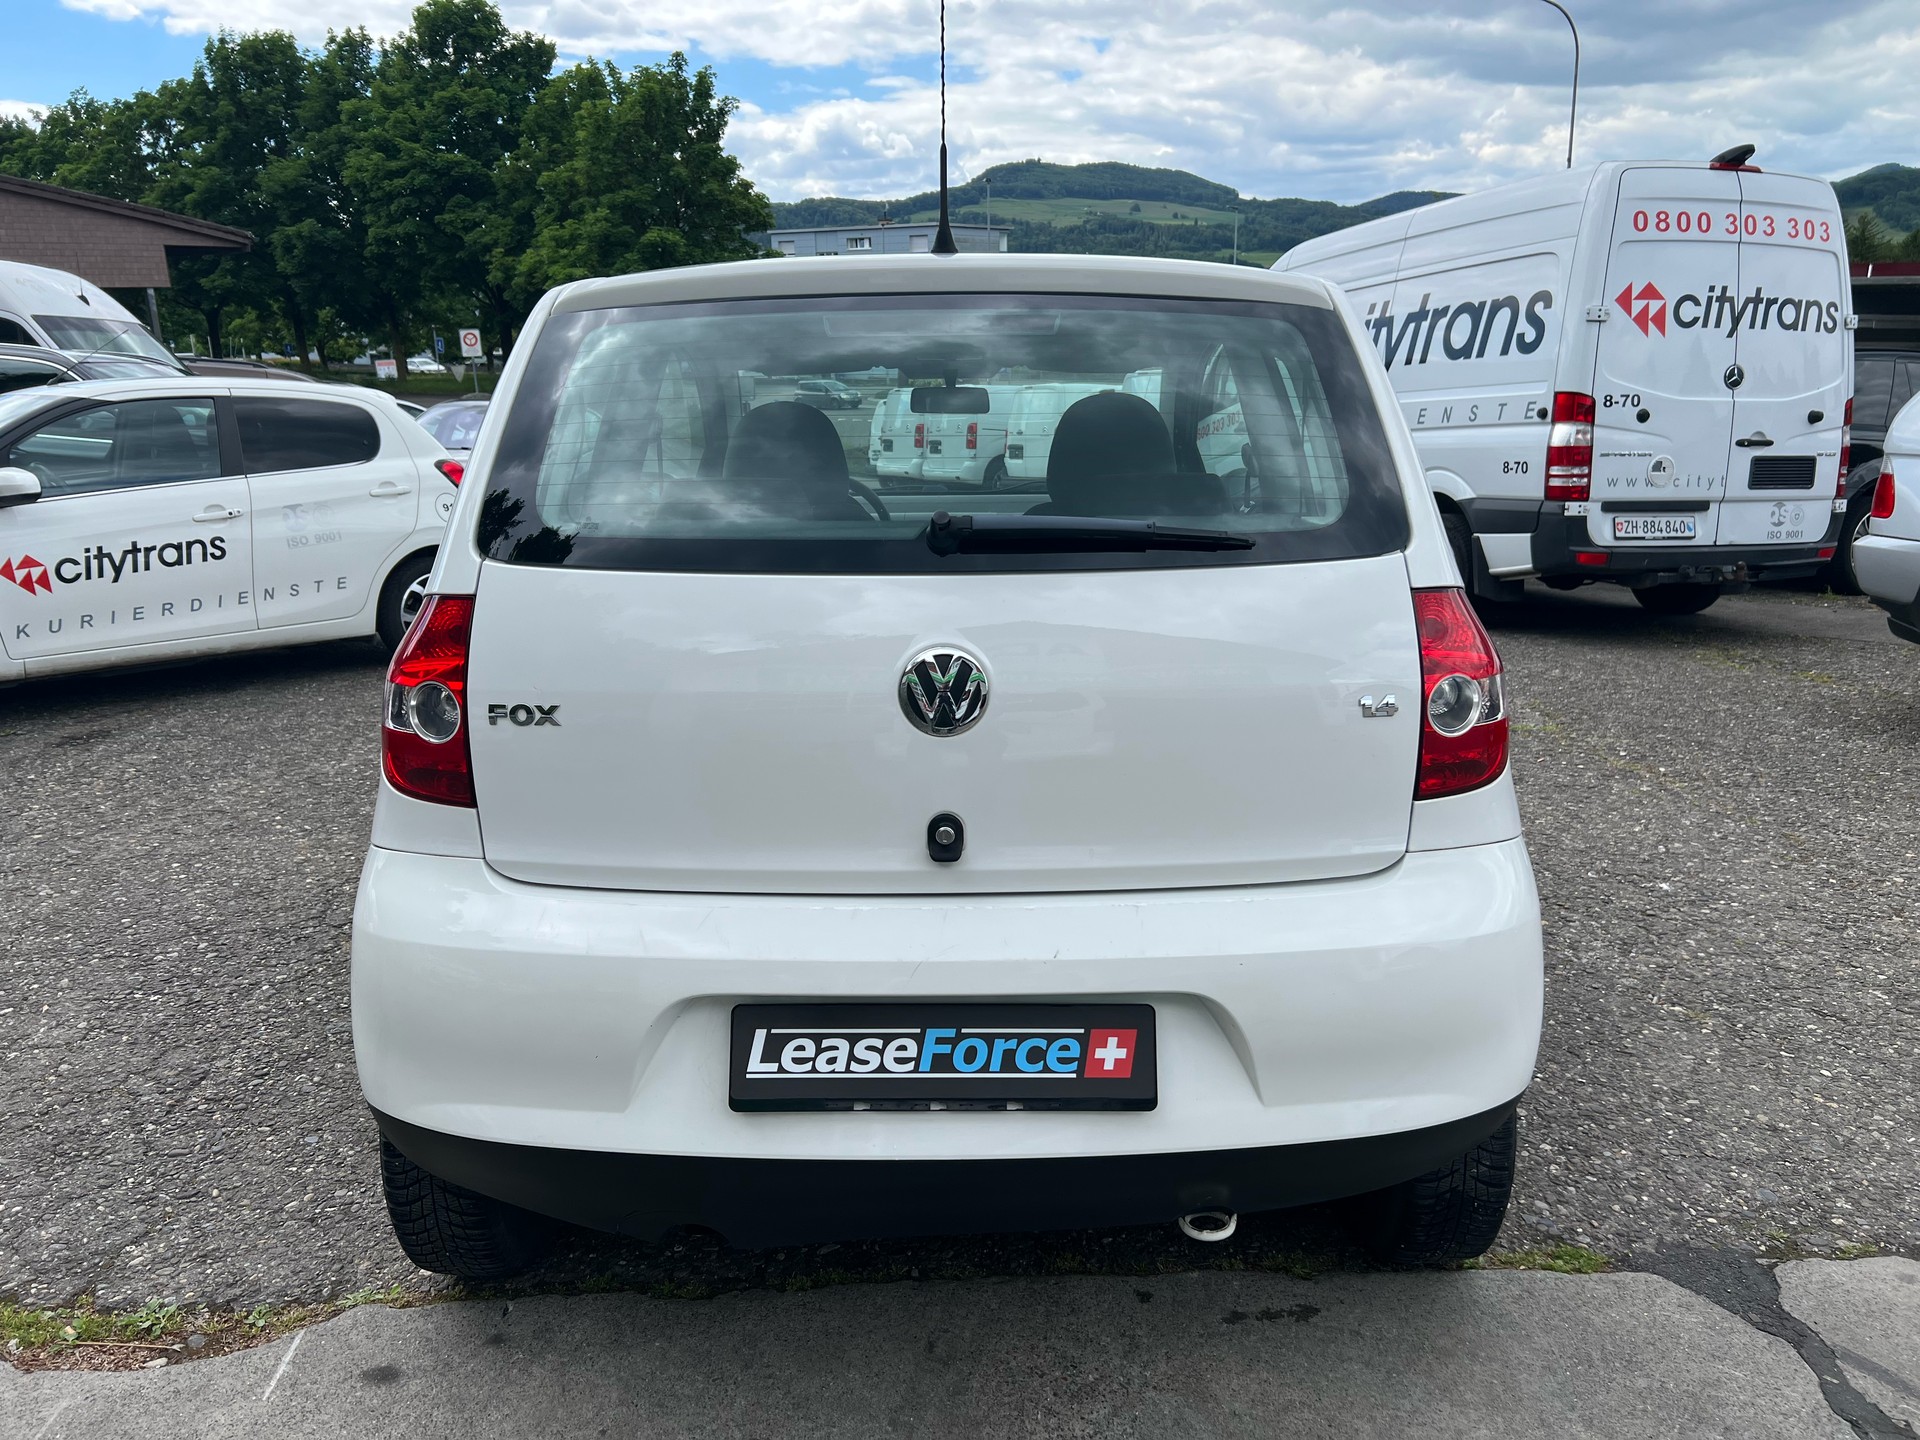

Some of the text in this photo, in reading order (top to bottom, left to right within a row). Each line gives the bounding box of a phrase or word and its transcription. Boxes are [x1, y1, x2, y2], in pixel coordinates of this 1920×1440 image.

[1633, 210, 1831, 242] 0800 303 303
[1673, 285, 1839, 338] citytrans
[1603, 394, 1641, 408] 8-70
[1502, 461, 1528, 474] 8-70
[287, 531, 342, 548] ISO 9001
[1766, 530, 1804, 540] ISO 9001
[54, 535, 227, 584] citytrans
[16, 576, 348, 640] KURIERDIENSTE
[487, 703, 562, 727] FOX
[747, 1028, 1081, 1073] LeaseForce
